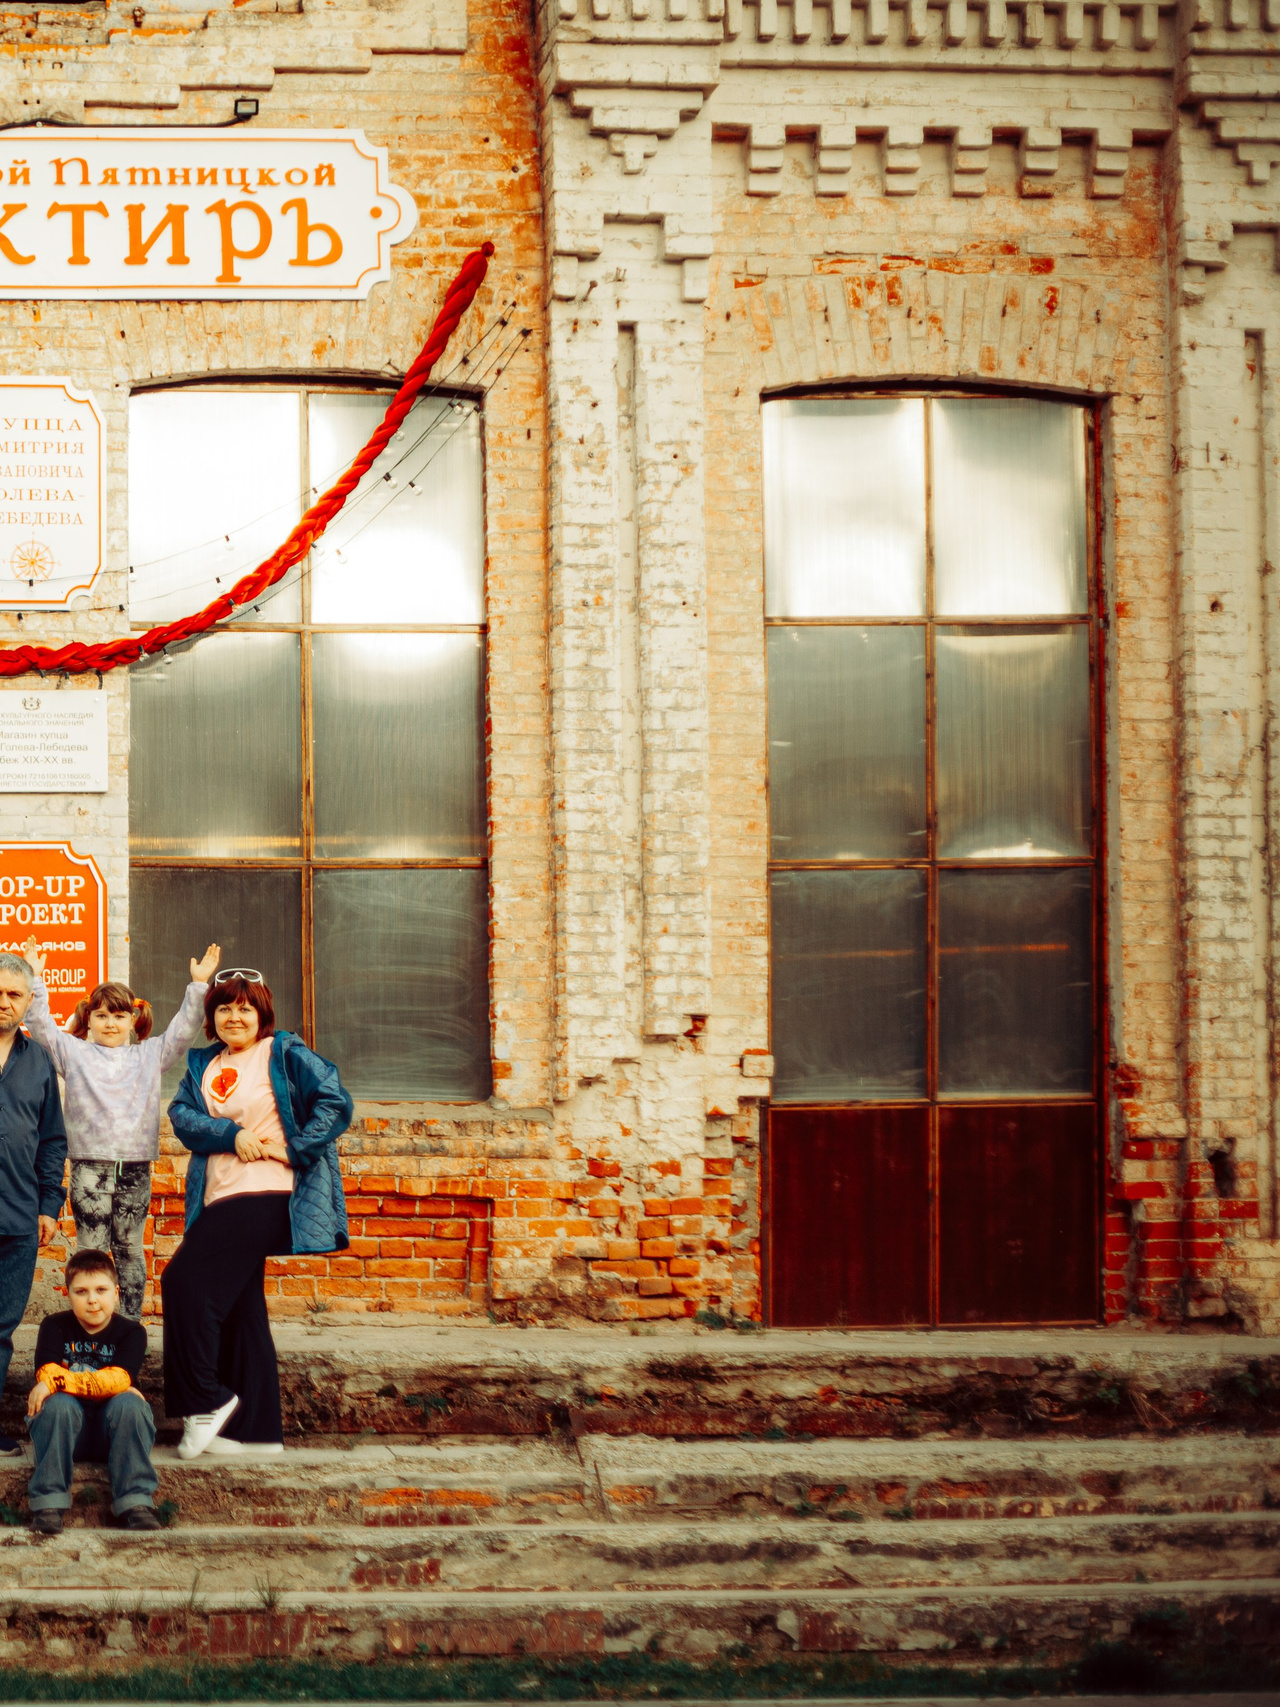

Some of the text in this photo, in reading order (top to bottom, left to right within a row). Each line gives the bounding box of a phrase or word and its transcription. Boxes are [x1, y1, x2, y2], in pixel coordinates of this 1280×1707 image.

[48, 156, 337, 194] Пятницкой
[39, 732, 69, 741] купца
[0, 743, 89, 753] Голева-Лебедева
[42, 968, 86, 985] GROUP
